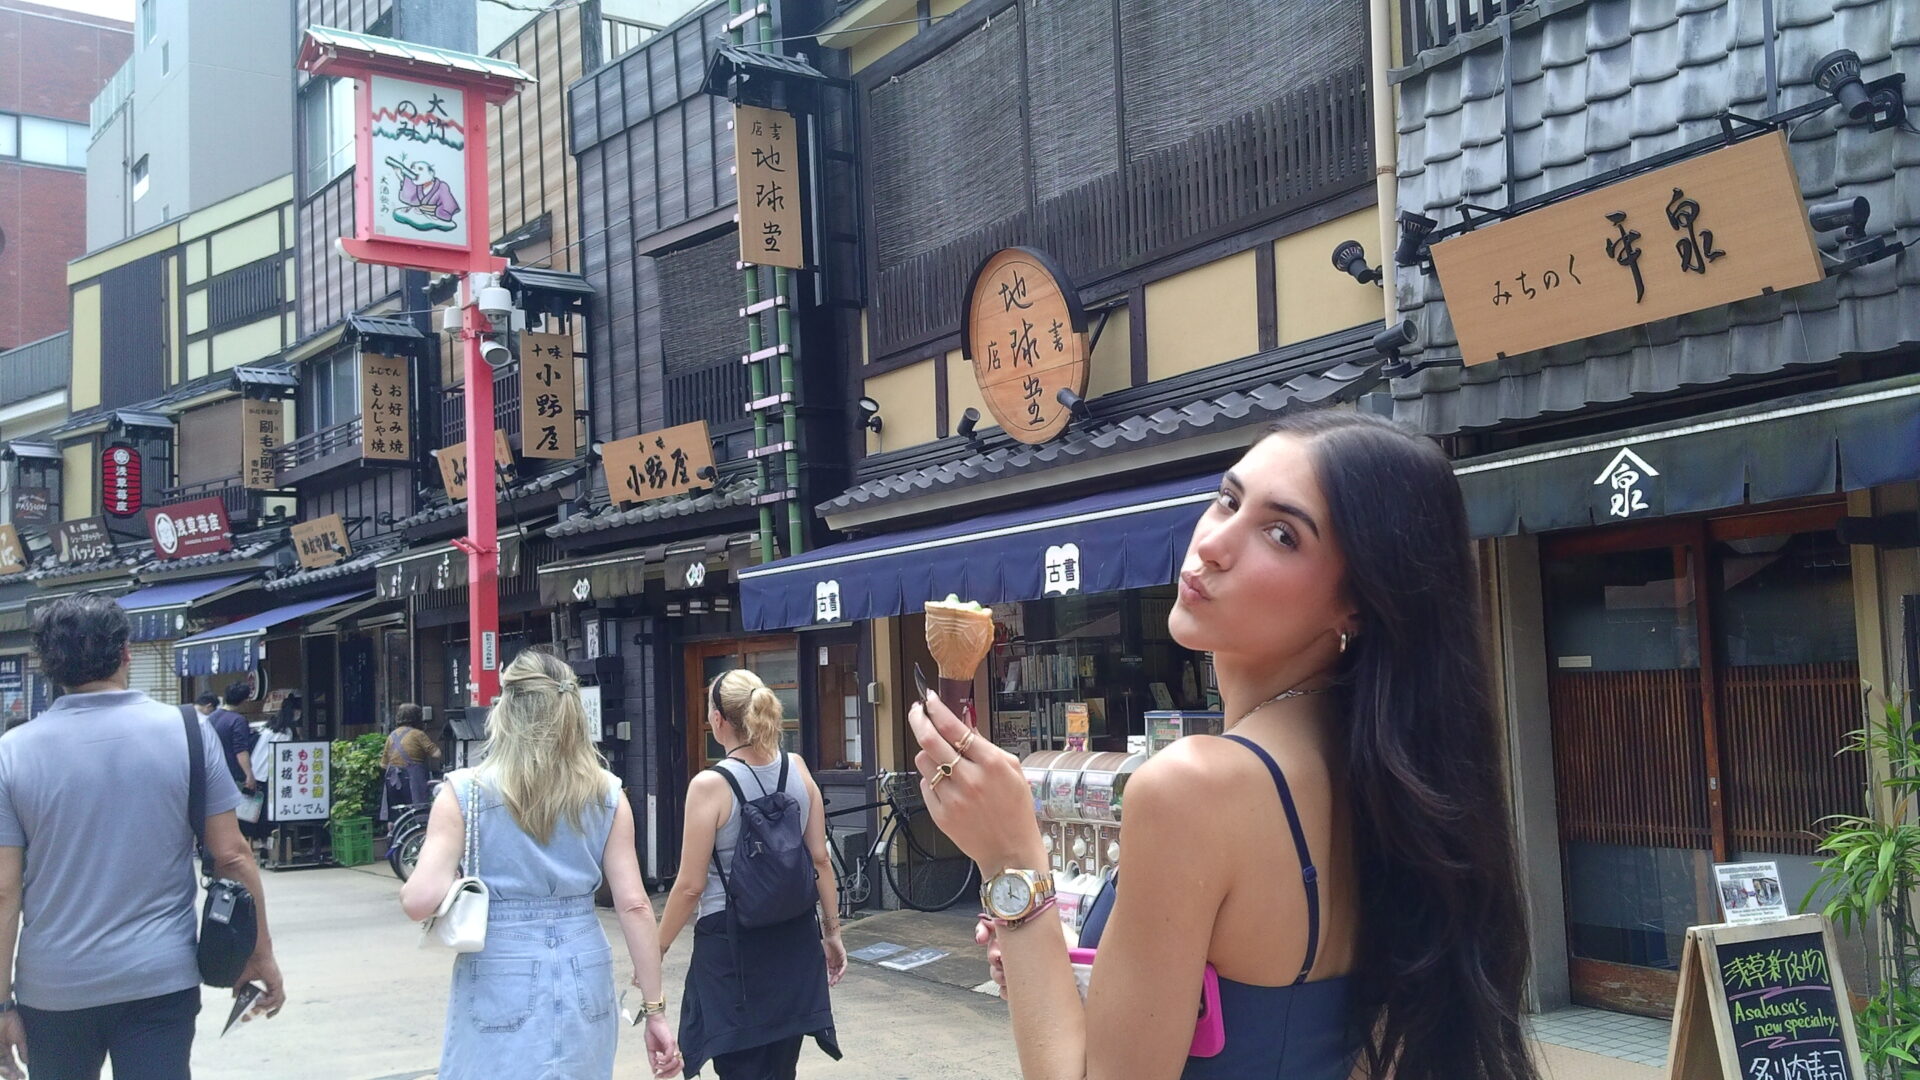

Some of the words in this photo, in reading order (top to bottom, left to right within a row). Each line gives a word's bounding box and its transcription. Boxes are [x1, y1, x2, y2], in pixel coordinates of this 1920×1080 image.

[1493, 254, 1582, 305] みちのく
[1605, 187, 1726, 303] 平泉
[371, 383, 386, 453] もんじゃ焼
[389, 384, 404, 453] お好み焼
[536, 364, 563, 450] 小野屋
[1046, 559, 1076, 583] 古書
[817, 593, 837, 612] 古書
[298, 749, 308, 795] もんじゃ
[280, 803, 325, 815] ふじでん
[1723, 949, 1829, 989] 浅草新名物
[1735, 997, 1807, 1025] Asakusa's
[1754, 1022, 1783, 1038] new
